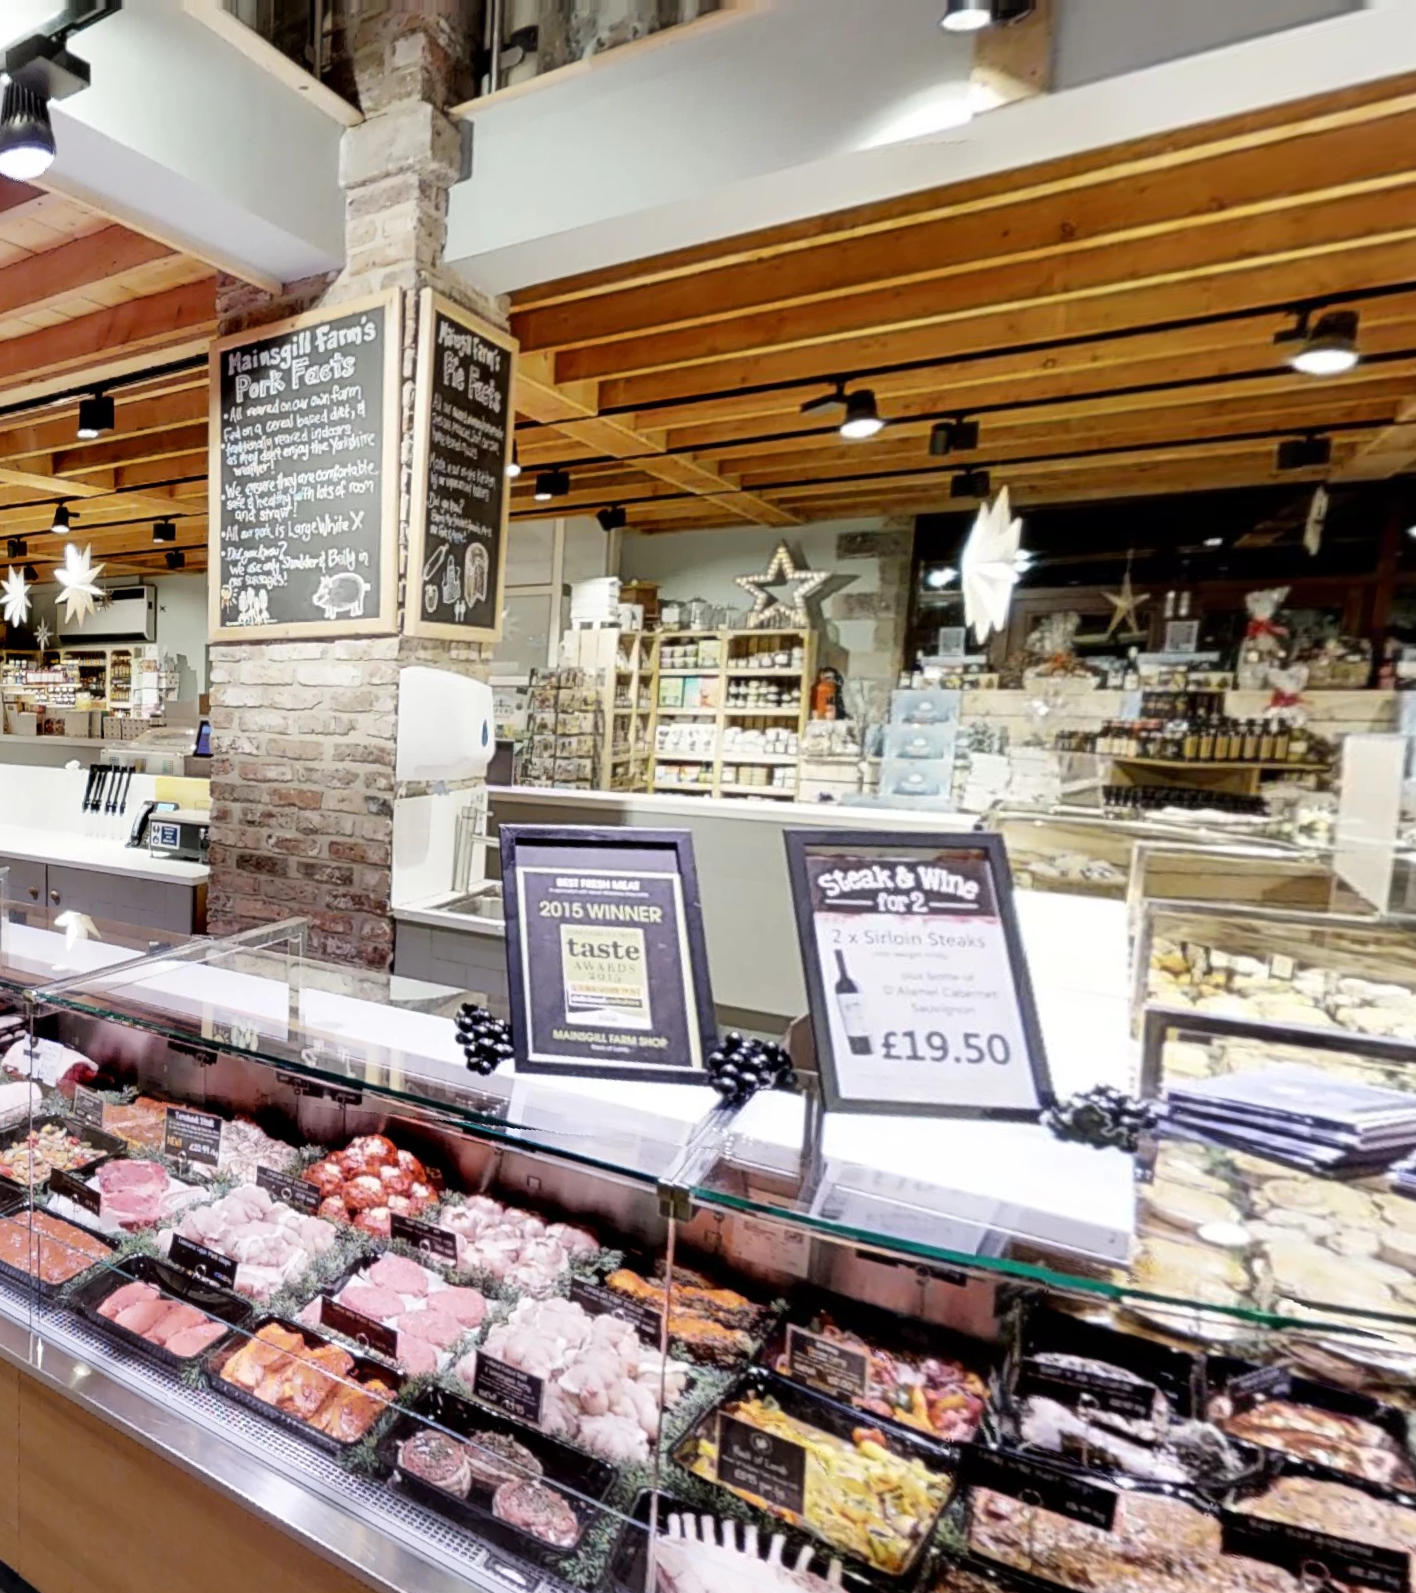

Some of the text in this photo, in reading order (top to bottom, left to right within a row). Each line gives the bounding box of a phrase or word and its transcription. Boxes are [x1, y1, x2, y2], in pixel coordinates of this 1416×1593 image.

[228, 316, 376, 375] Mainsgill Farm's
[235, 352, 356, 403] Pork Facts
[443, 350, 502, 414] Pie Facts
[230, 385, 362, 423] All reared on our own farm
[224, 427, 241, 442] Fed
[242, 427, 253, 437] on
[266, 414, 293, 432] cereal
[296, 409, 328, 426] based
[274, 428, 309, 445] reared
[311, 424, 352, 440] indoors
[282, 442, 309, 461] enjoy
[310, 440, 329, 454] the
[329, 431, 376, 455] Yorkshire
[225, 481, 243, 498] We
[276, 472, 297, 494] they
[298, 473, 315, 485] are
[317, 484, 334, 500] lots
[335, 480, 347, 499] of
[348, 480, 374, 494] room
[225, 524, 239, 542] All
[274, 523, 285, 538] is
[287, 520, 318, 542] Large
[317, 512, 350, 537] White
[350, 510, 365, 531] X
[234, 507, 256, 522] and
[327, 547, 356, 572] Belly
[358, 549, 369, 566] in
[556, 877, 641, 891] BEST FRESH MEAT
[817, 865, 895, 897] Steak
[895, 865, 915, 889] &
[539, 901, 663, 923] 2015 WINNER
[876, 891, 929, 913] for 2
[566, 937, 640, 961] taste
[831, 928, 986, 949] 2 x Sirloin Steaks
[573, 961, 636, 973] AWARDS
[942, 987, 998, 999] Cabernet
[911, 1002, 975, 1016] Sauvignon
[552, 1029, 668, 1048] MAINSGILL FARM SHOP
[882, 1030, 1011, 1065] £19.50
